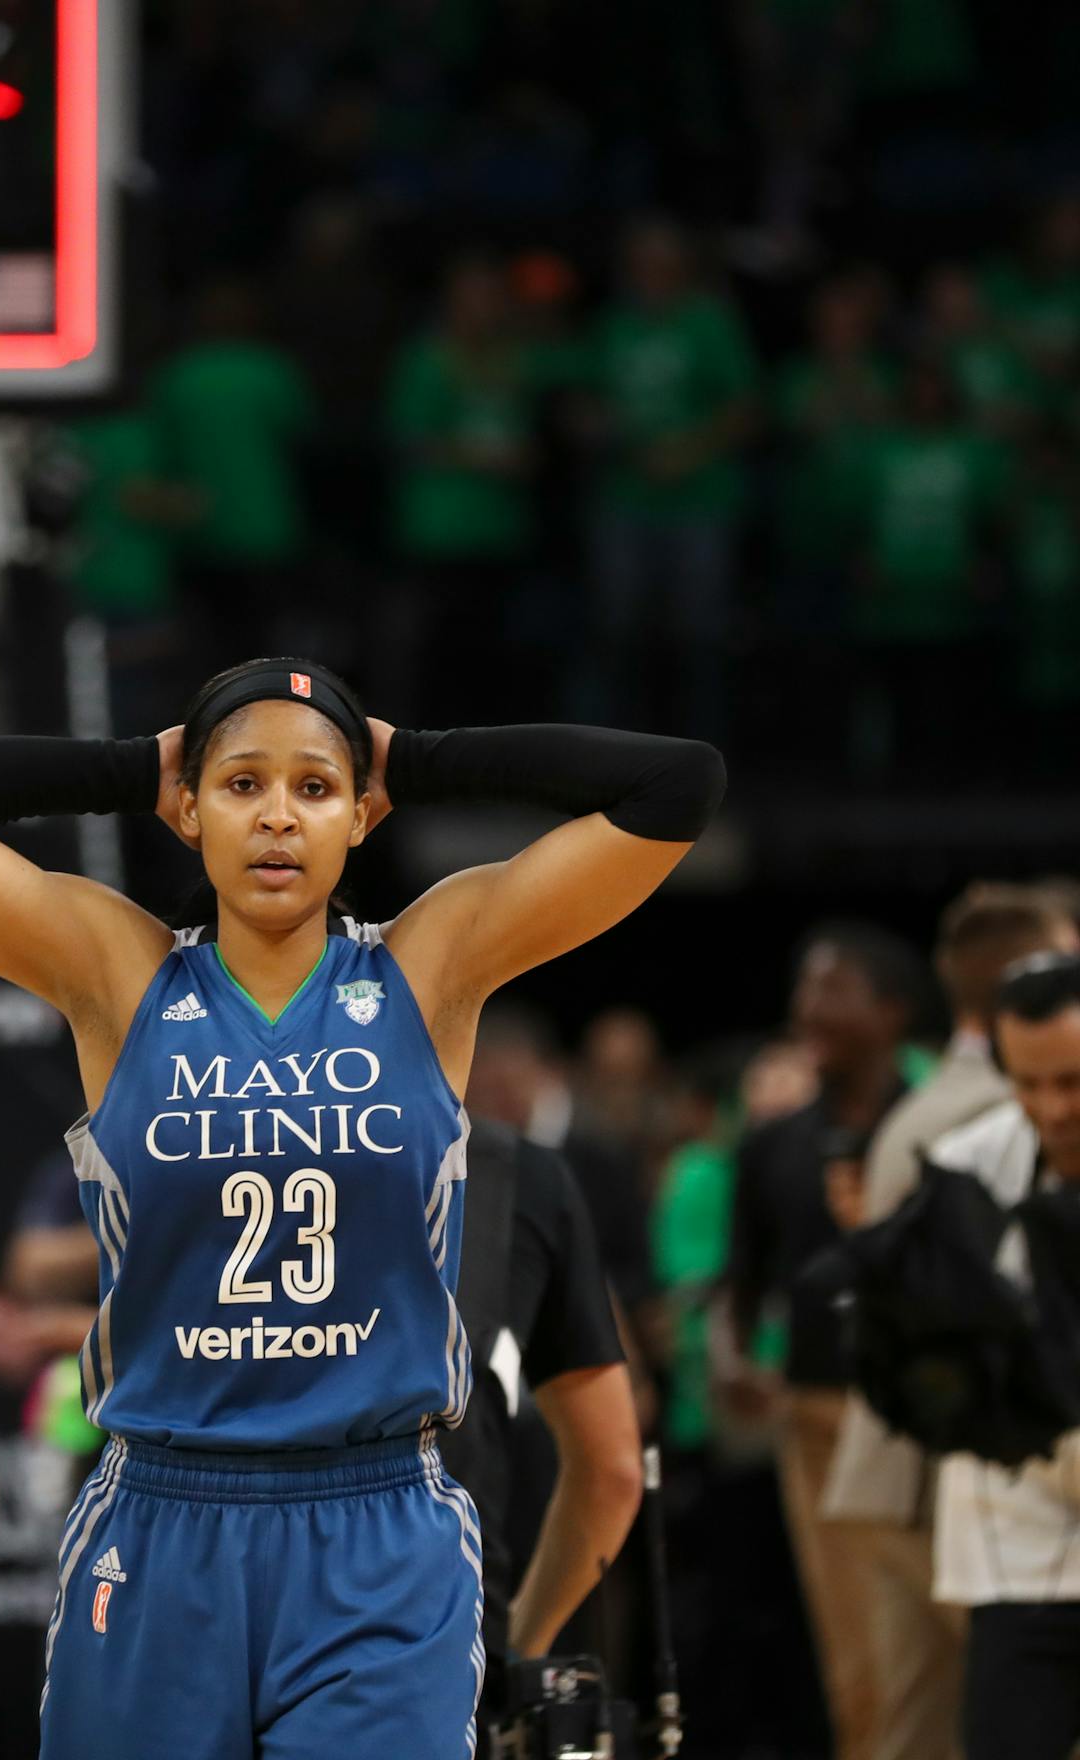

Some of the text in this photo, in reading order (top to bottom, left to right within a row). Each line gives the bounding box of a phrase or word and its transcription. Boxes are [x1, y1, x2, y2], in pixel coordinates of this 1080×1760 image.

[162, 1009, 208, 1022] adidas
[166, 1048, 381, 1101] MAYO
[145, 1104, 404, 1162] CLINIC
[218, 1167, 337, 1305] 23
[174, 1316, 358, 1361] verizon
[92, 1565, 127, 1583] adidas
